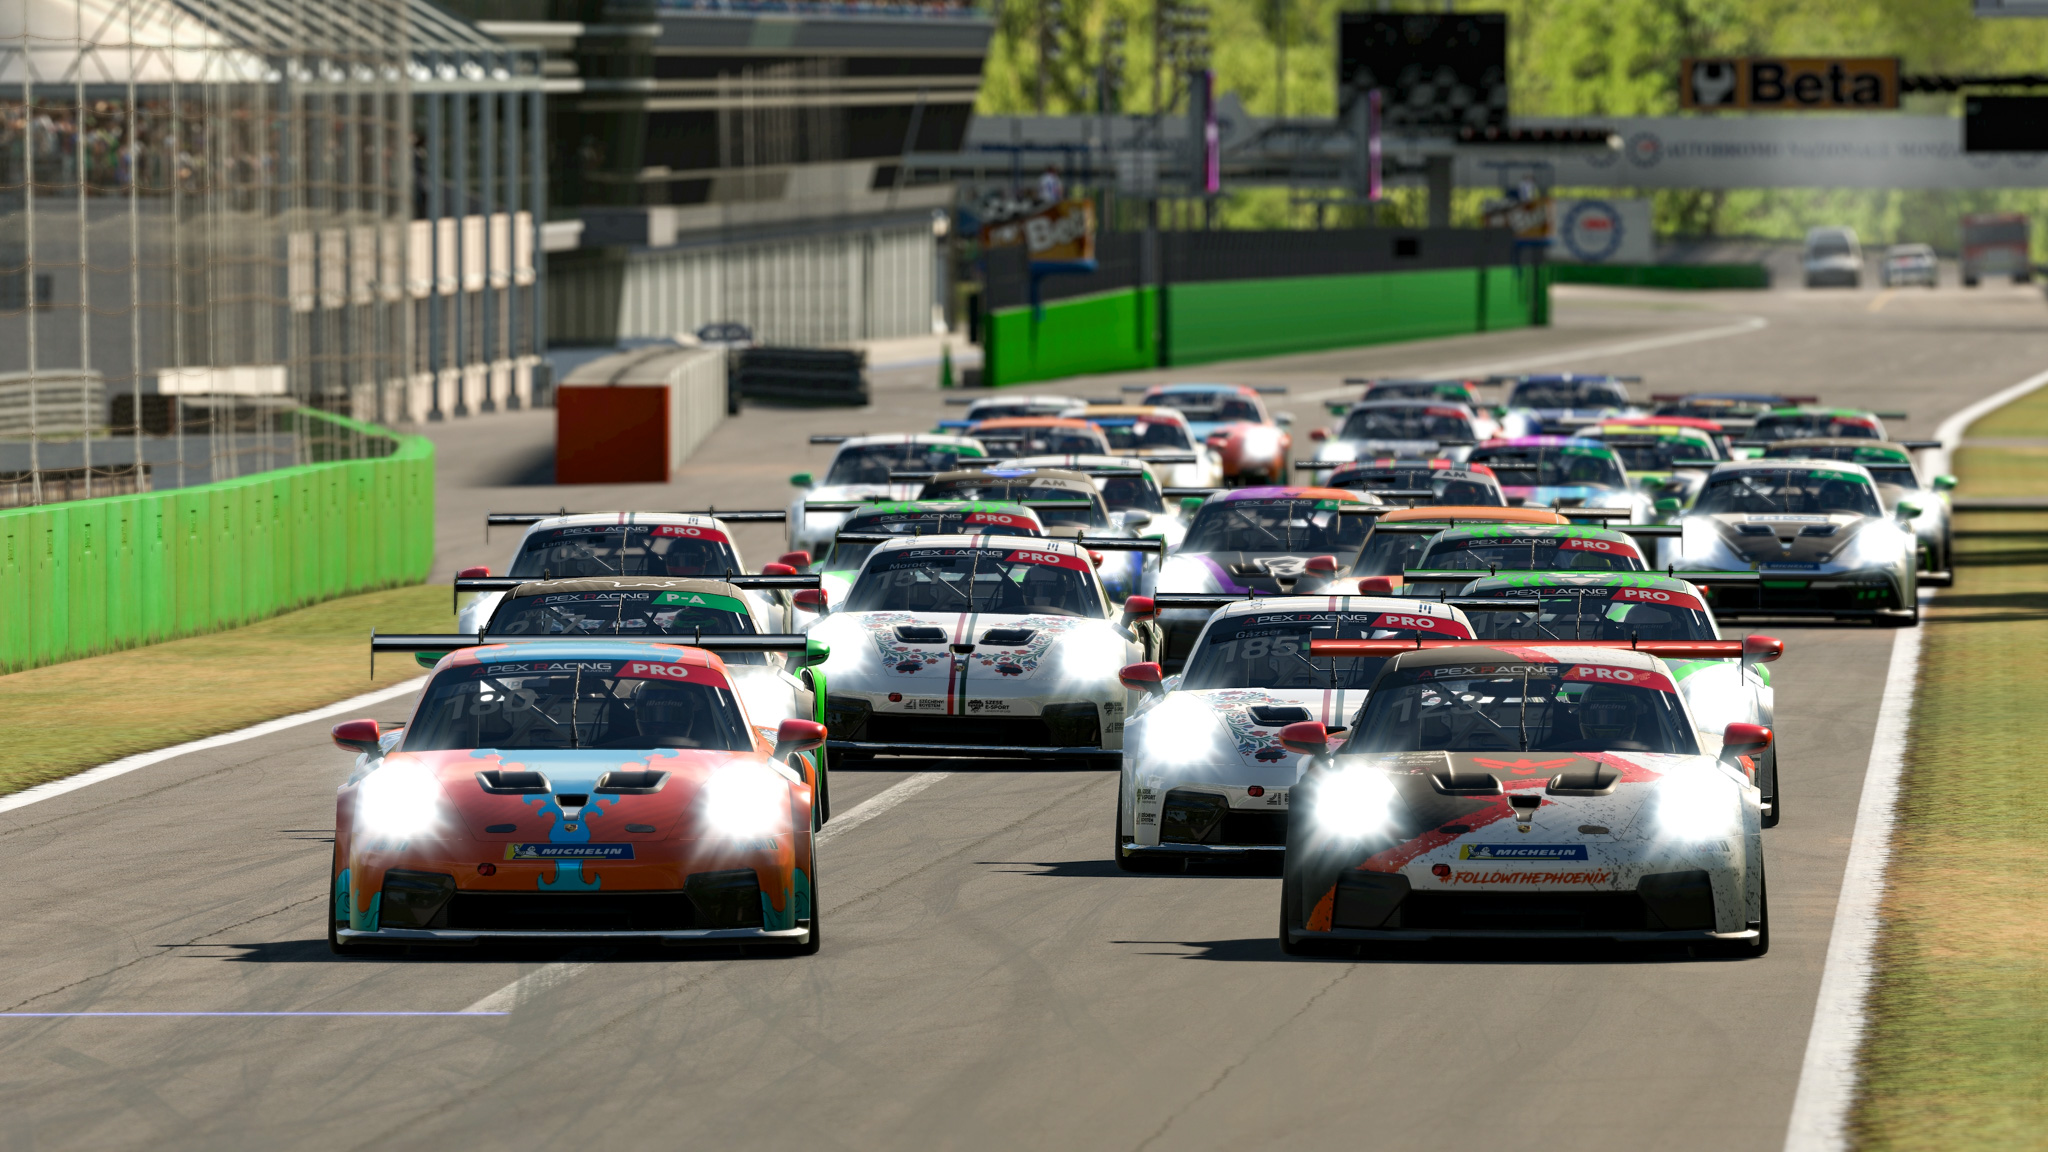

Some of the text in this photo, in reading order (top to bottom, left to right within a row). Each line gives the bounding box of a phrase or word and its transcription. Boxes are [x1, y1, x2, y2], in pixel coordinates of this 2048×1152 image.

[1752, 63, 1881, 104] Beta
[1442, 471, 1468, 479] AM
[1041, 479, 1067, 487] AM
[870, 513, 907, 523] APEX
[975, 514, 1012, 524] PRO
[551, 526, 592, 537] APEX
[662, 526, 701, 537] PRO
[1456, 539, 1499, 548] APEX
[1571, 539, 1610, 550] PRO
[898, 549, 942, 559] APEX
[1018, 551, 1060, 564] PRO
[667, 592, 706, 605] P-A
[1495, 589, 1540, 597] APEX
[1624, 589, 1670, 601] PRO
[530, 594, 581, 606] APEX
[1242, 614, 1294, 625] APEX
[1386, 615, 1435, 628] PRO
[1218, 636, 1300, 663] 185
[470, 663, 530, 677] APEX
[632, 662, 688, 678] PRO
[1418, 666, 1477, 678] APEX
[1579, 667, 1634, 681] PRO
[443, 688, 537, 720] 180
[1391, 691, 1484, 723] 123
[541, 847, 623, 856] MICHELIN
